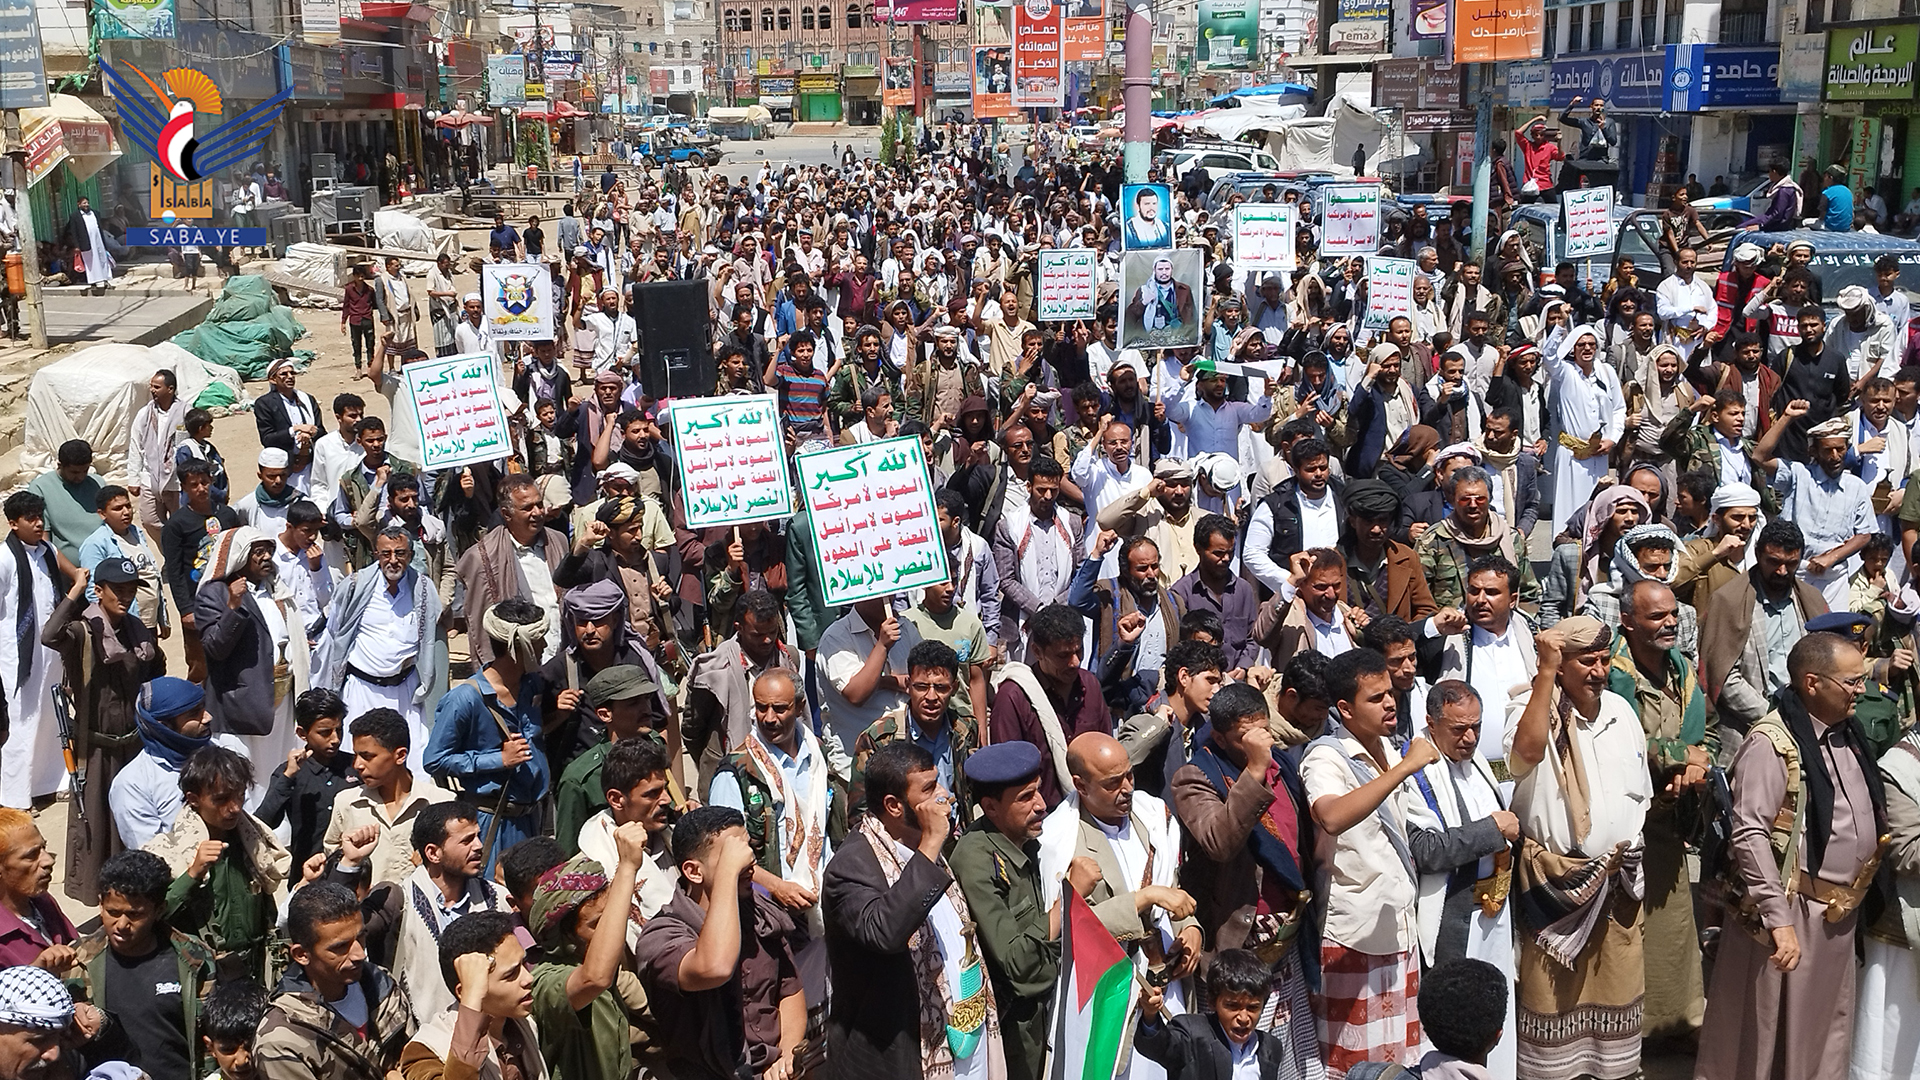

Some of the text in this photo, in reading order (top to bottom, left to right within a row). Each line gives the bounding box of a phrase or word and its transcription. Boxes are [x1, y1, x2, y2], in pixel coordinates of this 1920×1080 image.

[894, 7, 908, 17] 4G
[1472, 9, 1507, 21] وكيل
[1509, 4, 1532, 20] أقرب
[1019, 25, 1057, 36] حماص
[1067, 21, 1100, 33] من أقرب
[1471, 26, 1520, 38] رصيدك
[1018, 41, 1058, 53] للهواتف
[1849, 30, 1895, 61] عالم
[1018, 58, 1058, 70] الذكية
[1715, 60, 1762, 79] حامد
[1556, 67, 1580, 89] حامد
[1582, 66, 1594, 93] أبو
[1620, 63, 1662, 87] محلات
[1828, 62, 1913, 88] البرمجة والصيانة
[1407, 116, 1427, 126] الجوال
[1429, 115, 1451, 125] وبرمجة
[1328, 192, 1376, 206] قاطعوا
[1570, 190, 1608, 207] الله أكبر
[1239, 212, 1287, 224] قاطعوا
[1570, 237, 1610, 252] النصر للإسلام
[1044, 254, 1093, 269] الله أكبر
[1373, 261, 1411, 276] الله أكبر
[1042, 302, 1092, 316] النصر للإسلام
[416, 364, 488, 392] الله أكبر
[681, 407, 771, 436] الله أكبر
[429, 431, 503, 460] النصر للإسلام
[810, 447, 917, 491] الله أكبر
[690, 469, 781, 494] اللعنة على اليهود
[812, 477, 923, 511] الموت لأمريكا
[693, 487, 784, 518] النصر للإسلام
[824, 526, 933, 564] اللعنة على اليهود
[829, 550, 940, 594] النصر للإسلام
